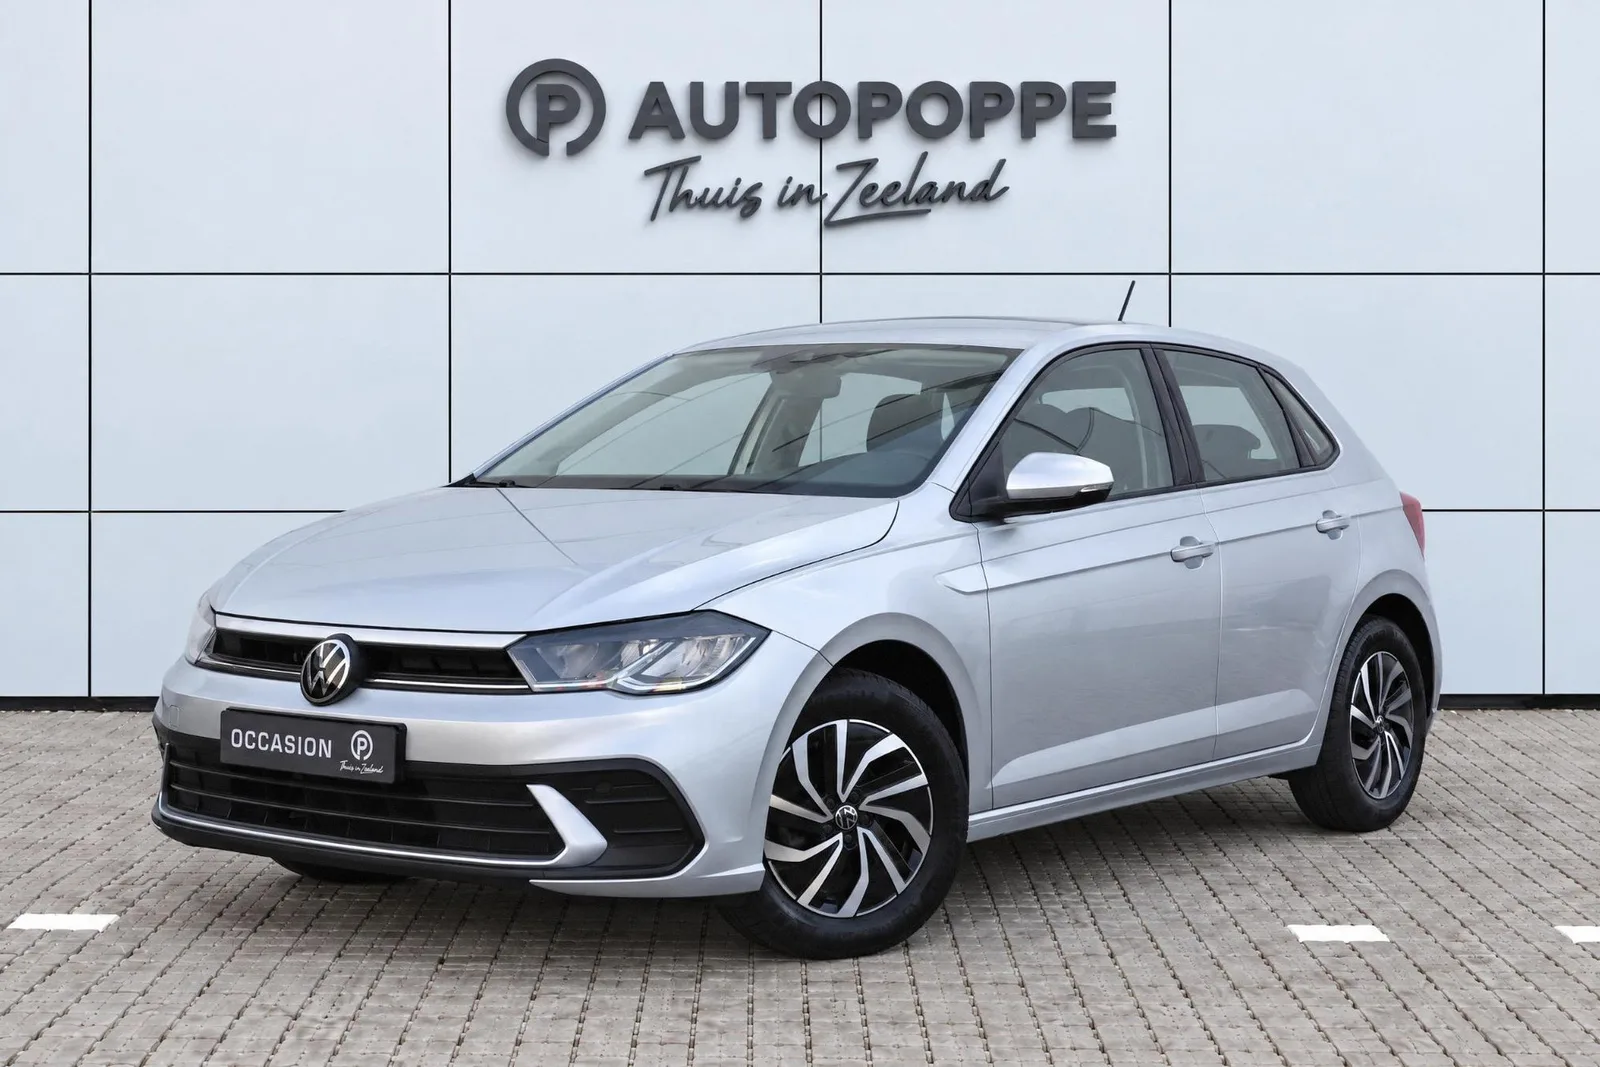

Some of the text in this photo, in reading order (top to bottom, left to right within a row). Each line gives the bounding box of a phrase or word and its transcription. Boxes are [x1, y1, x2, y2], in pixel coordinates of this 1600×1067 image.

[628, 80, 1117, 140] AUTOPOPPE
[643, 151, 1010, 227] Thuis in Zeeland
[231, 728, 332, 759] OCCASION
